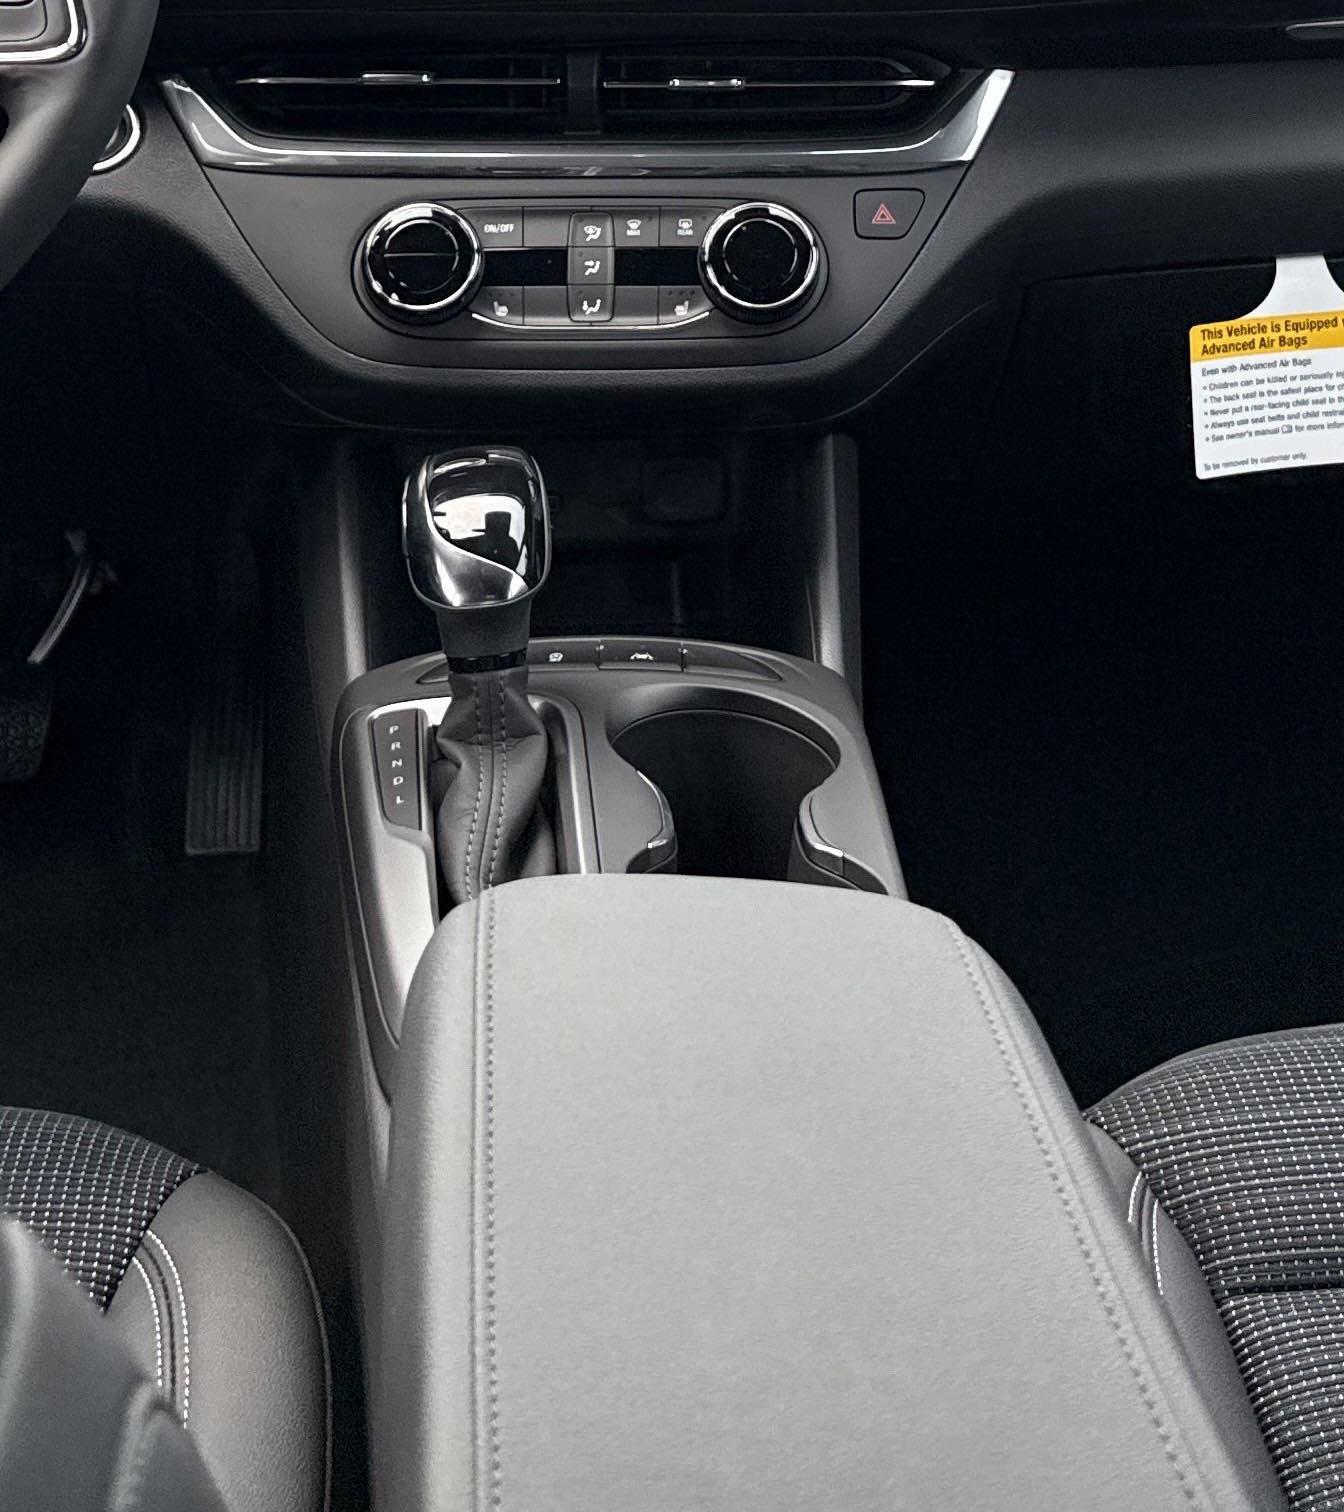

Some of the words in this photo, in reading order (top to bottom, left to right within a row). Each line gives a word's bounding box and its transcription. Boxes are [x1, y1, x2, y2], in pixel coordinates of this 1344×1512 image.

[484, 223, 515, 234] ON/OFF
[1201, 327, 1223, 341] This
[1226, 322, 1268, 337] Vehicle
[1270, 320, 1282, 333] is
[1284, 316, 1339, 333] Equipped
[1202, 337, 1256, 356] Advanced
[1258, 335, 1276, 350] Air
[1278, 334, 1309, 349] Bags
[1221, 364, 1237, 373] with
[1240, 360, 1277, 371] Advanced
[1279, 359, 1290, 368] Air
[1292, 358, 1312, 367] Bags
[389, 725, 399, 735] P
[391, 741, 401, 751] R
[391, 758, 403, 768] N
[393, 776, 404, 786] D
[396, 795, 405, 804] L
